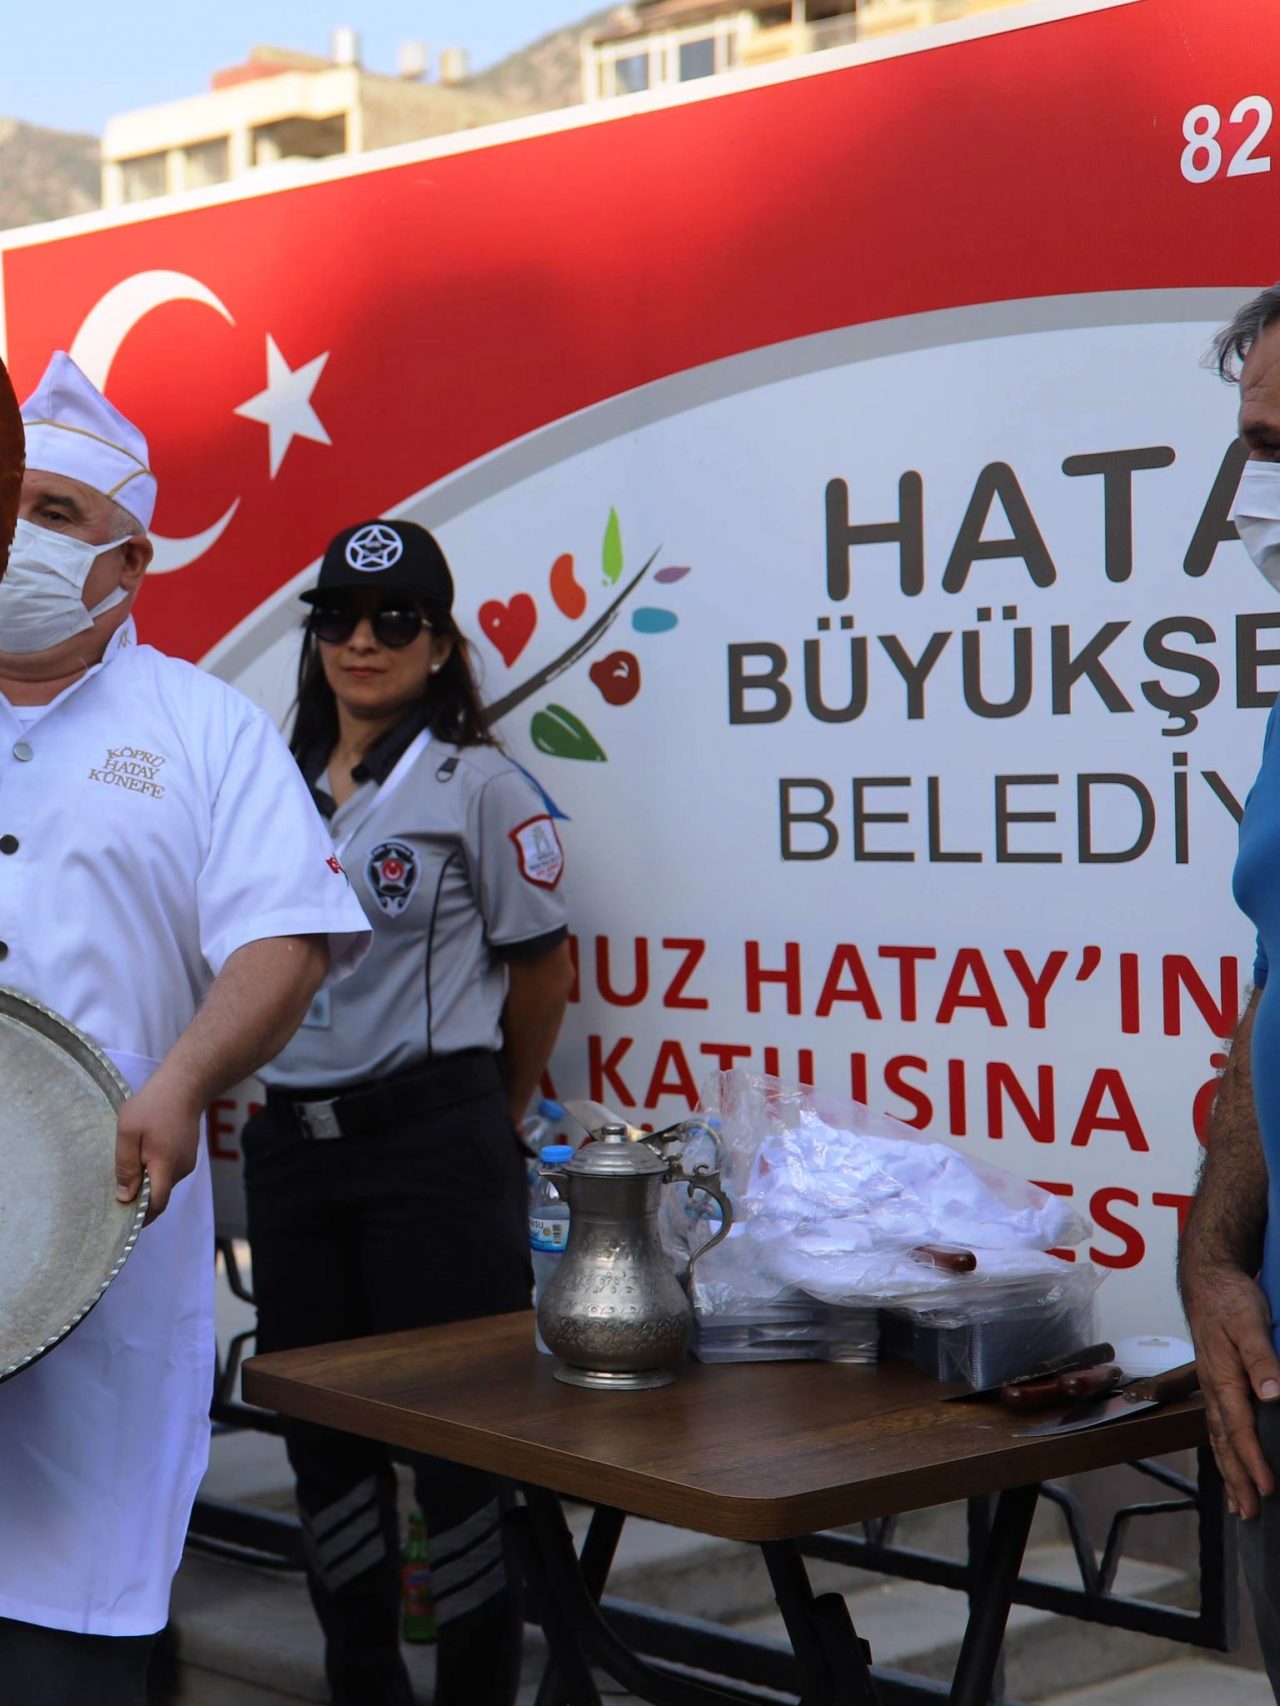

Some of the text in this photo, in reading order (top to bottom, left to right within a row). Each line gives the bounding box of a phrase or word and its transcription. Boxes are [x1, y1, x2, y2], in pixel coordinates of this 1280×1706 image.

[1180, 94, 1273, 184] 82
[727, 604, 1280, 737] BÜYÜKŞE
[103, 759, 160, 780] HATAY
[106, 746, 167, 768] KÖPRÜ
